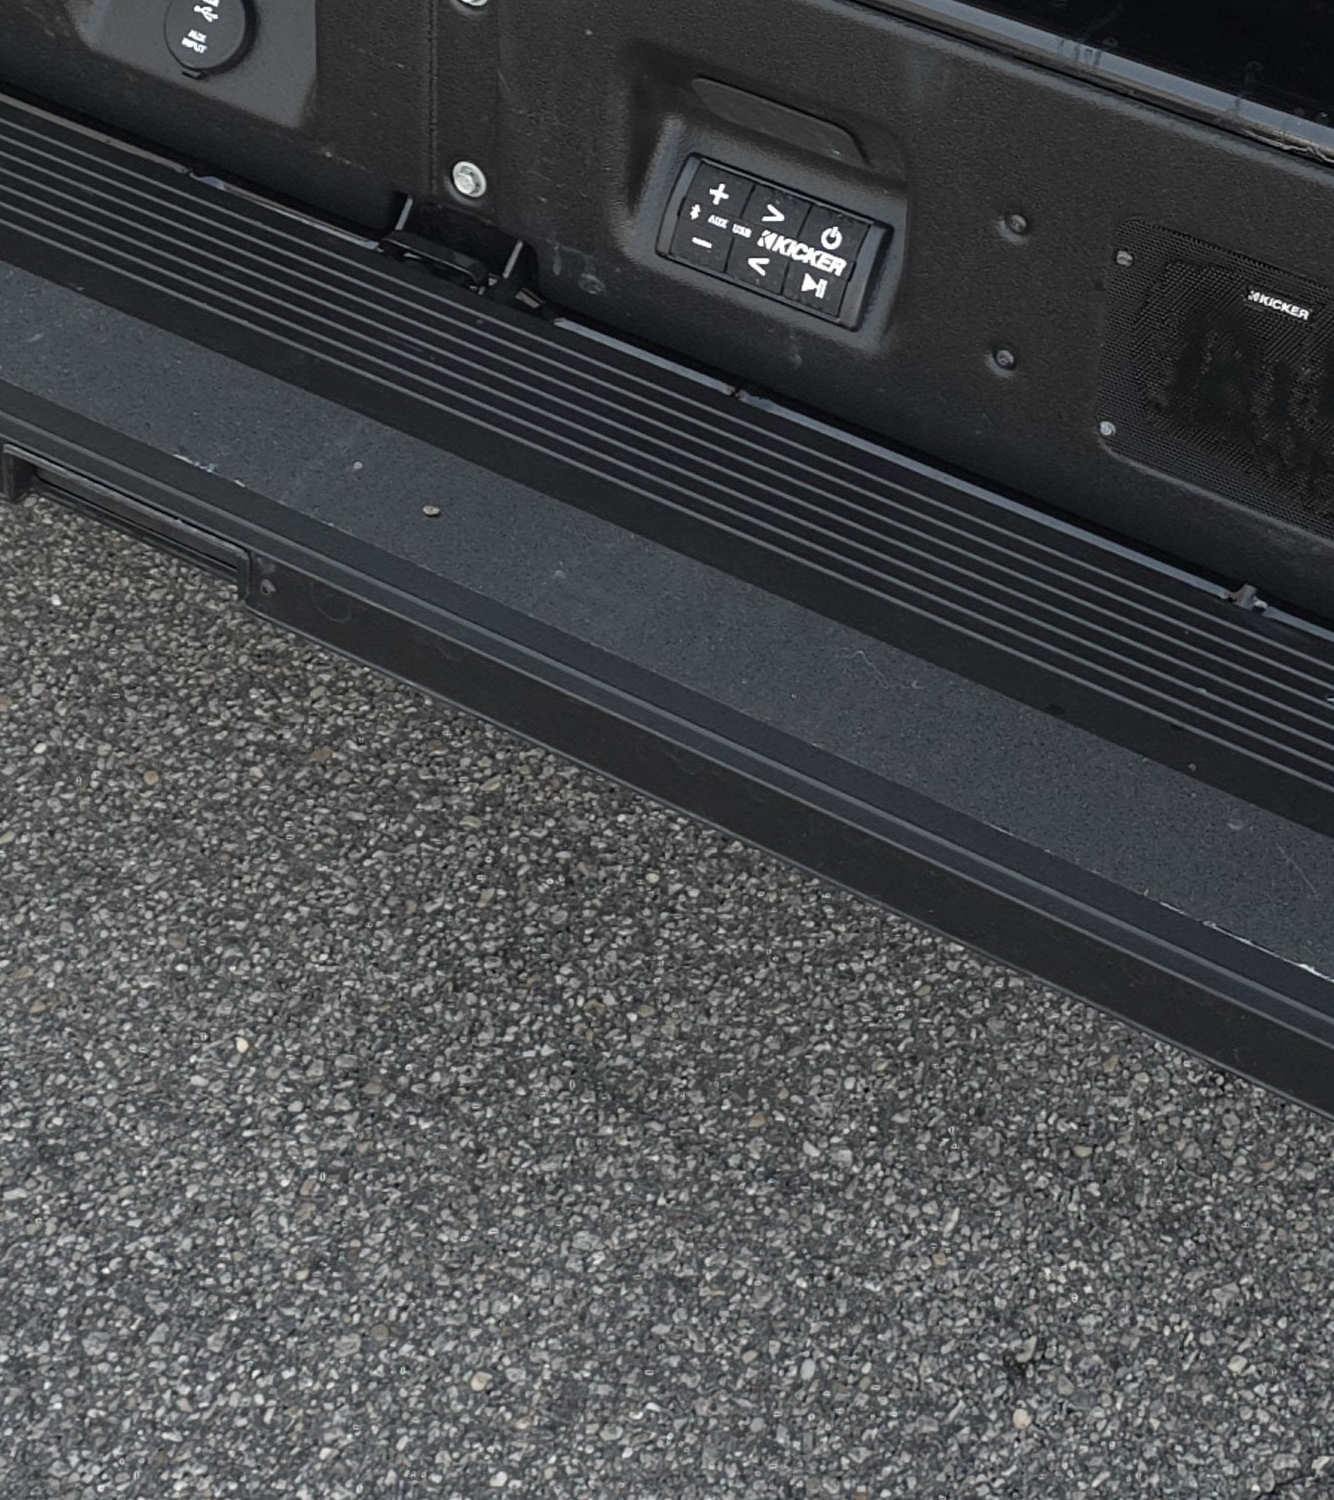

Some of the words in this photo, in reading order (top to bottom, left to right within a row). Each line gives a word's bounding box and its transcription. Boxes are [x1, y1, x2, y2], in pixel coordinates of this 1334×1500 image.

[707, 214, 729, 229] AUX
[732, 223, 752, 238] USB
[771, 234, 848, 277] KICKER
[1259, 293, 1309, 321] KICKER
